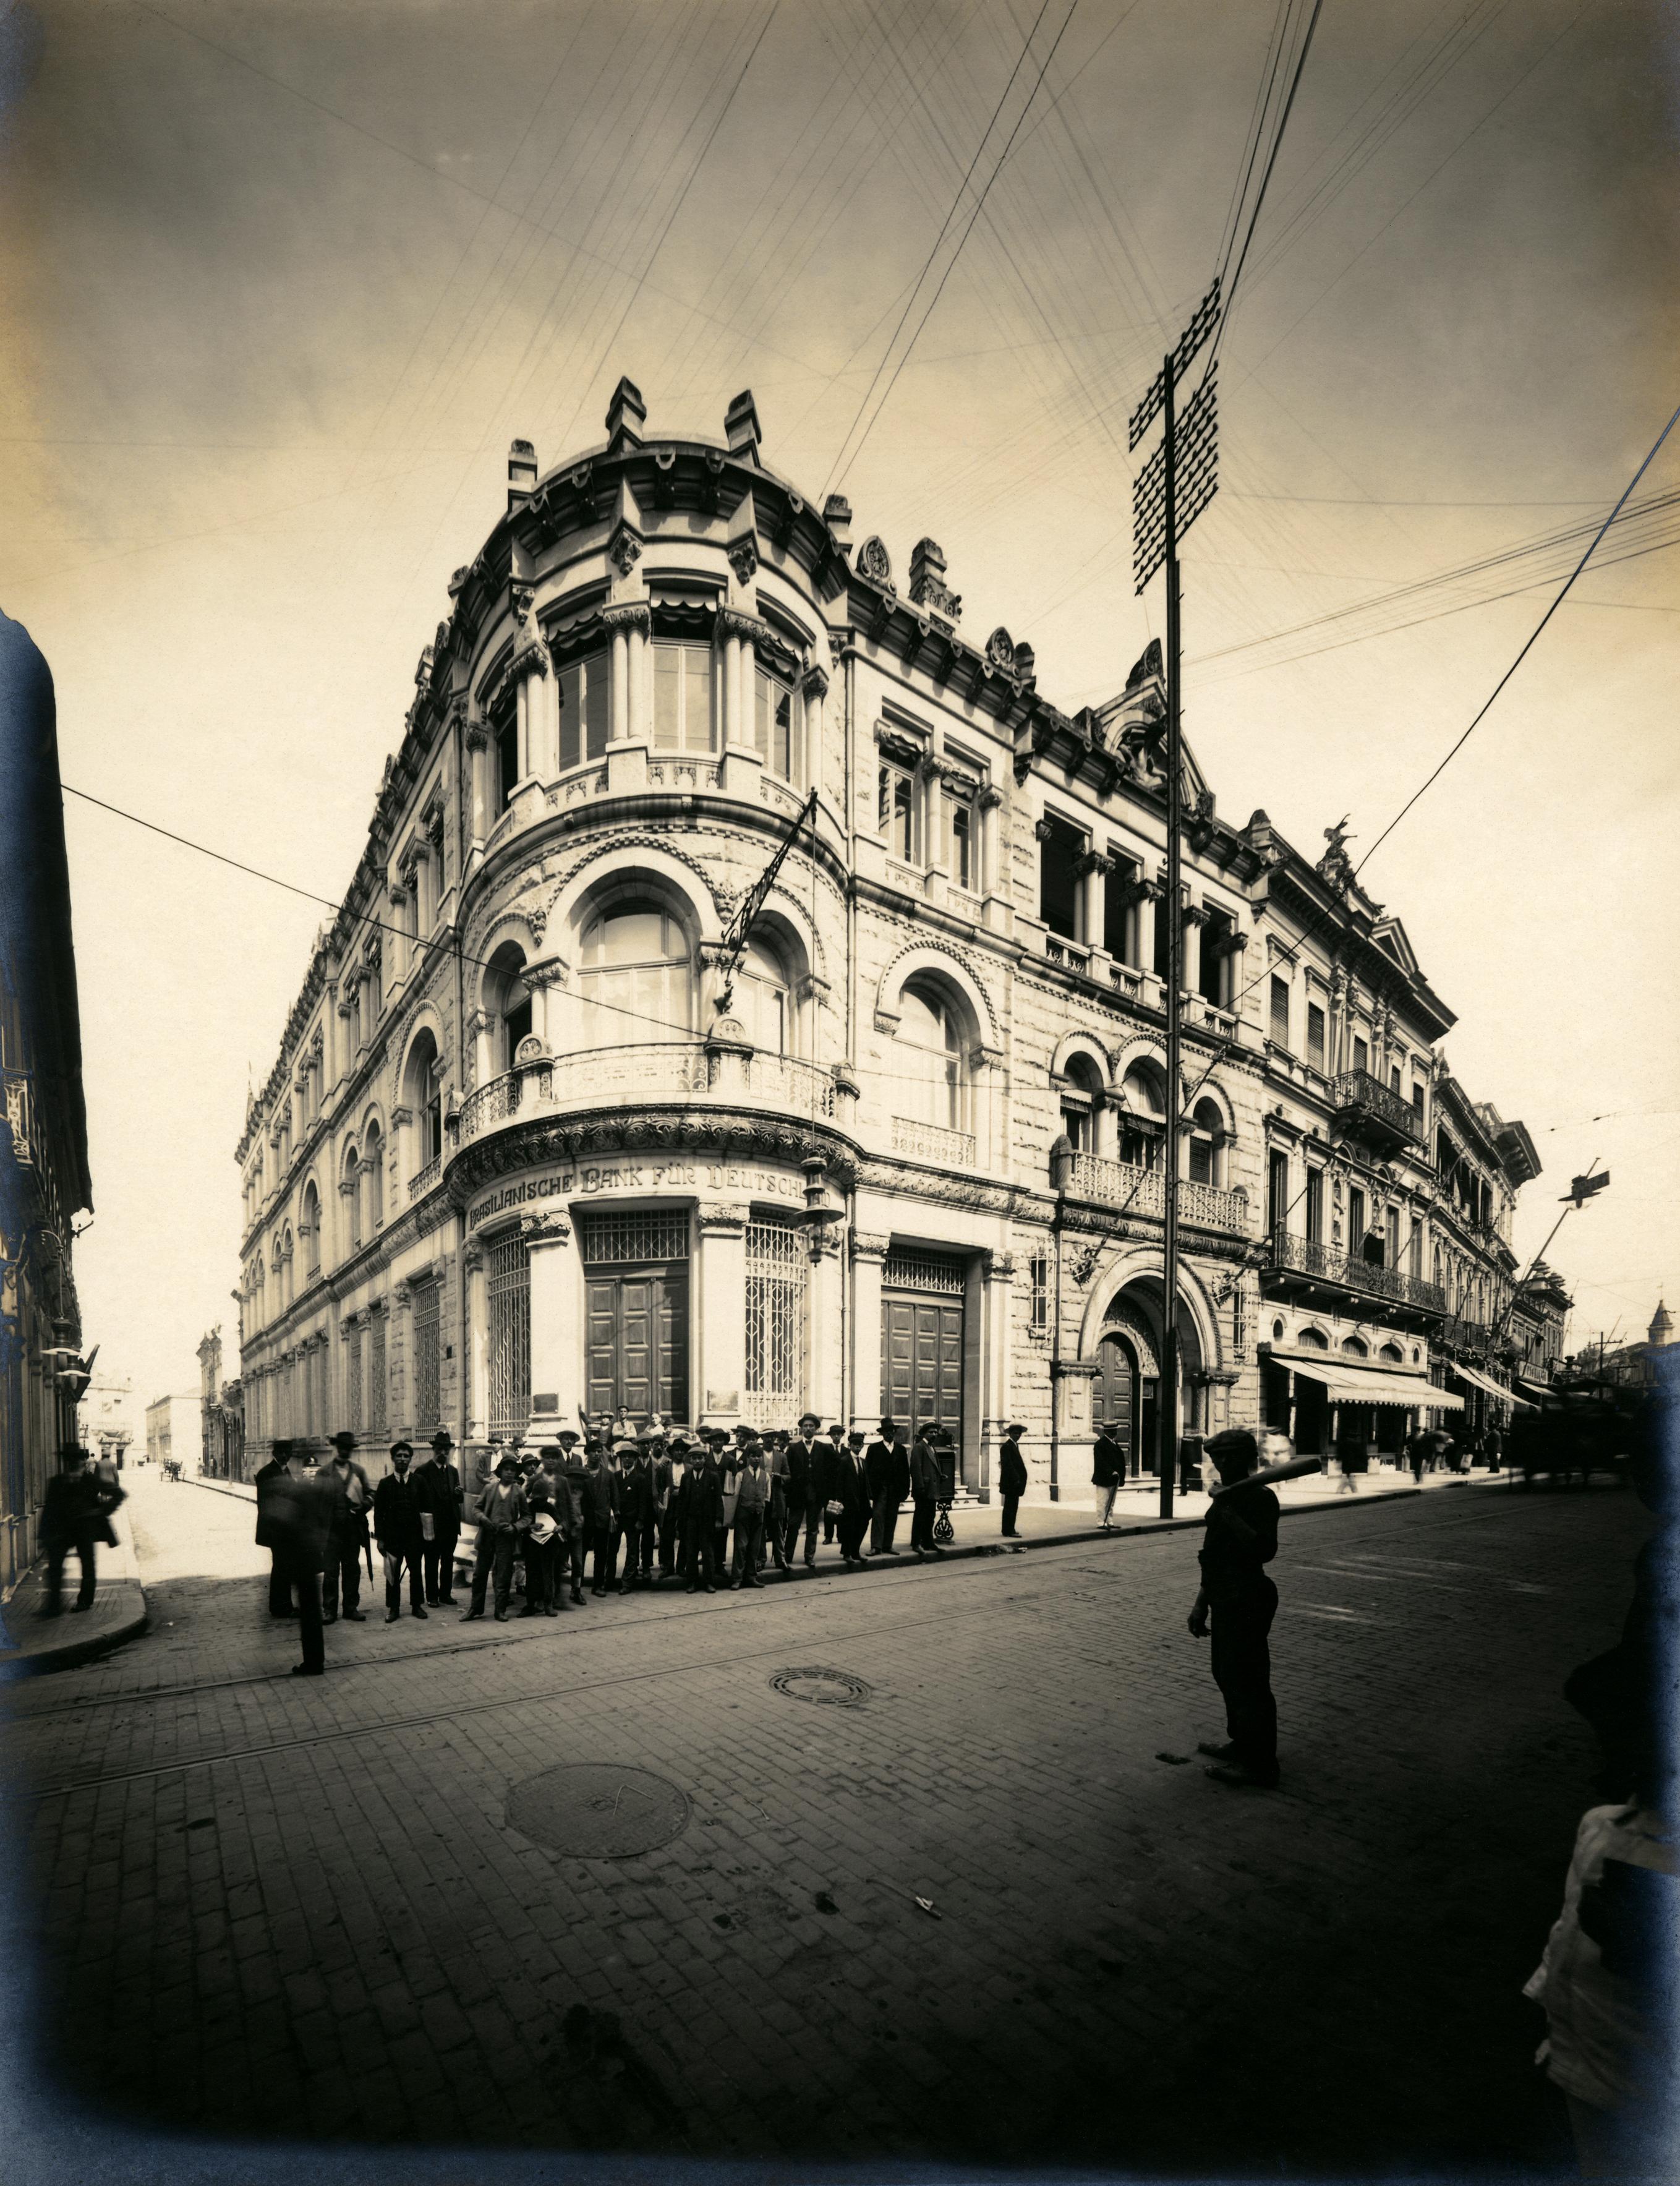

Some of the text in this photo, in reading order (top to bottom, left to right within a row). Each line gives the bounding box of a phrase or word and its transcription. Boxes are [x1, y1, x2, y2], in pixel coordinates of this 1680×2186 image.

[469, 1161, 831, 1231] BRASILIANISCHE BANK FÜR DEUTSCHLD
